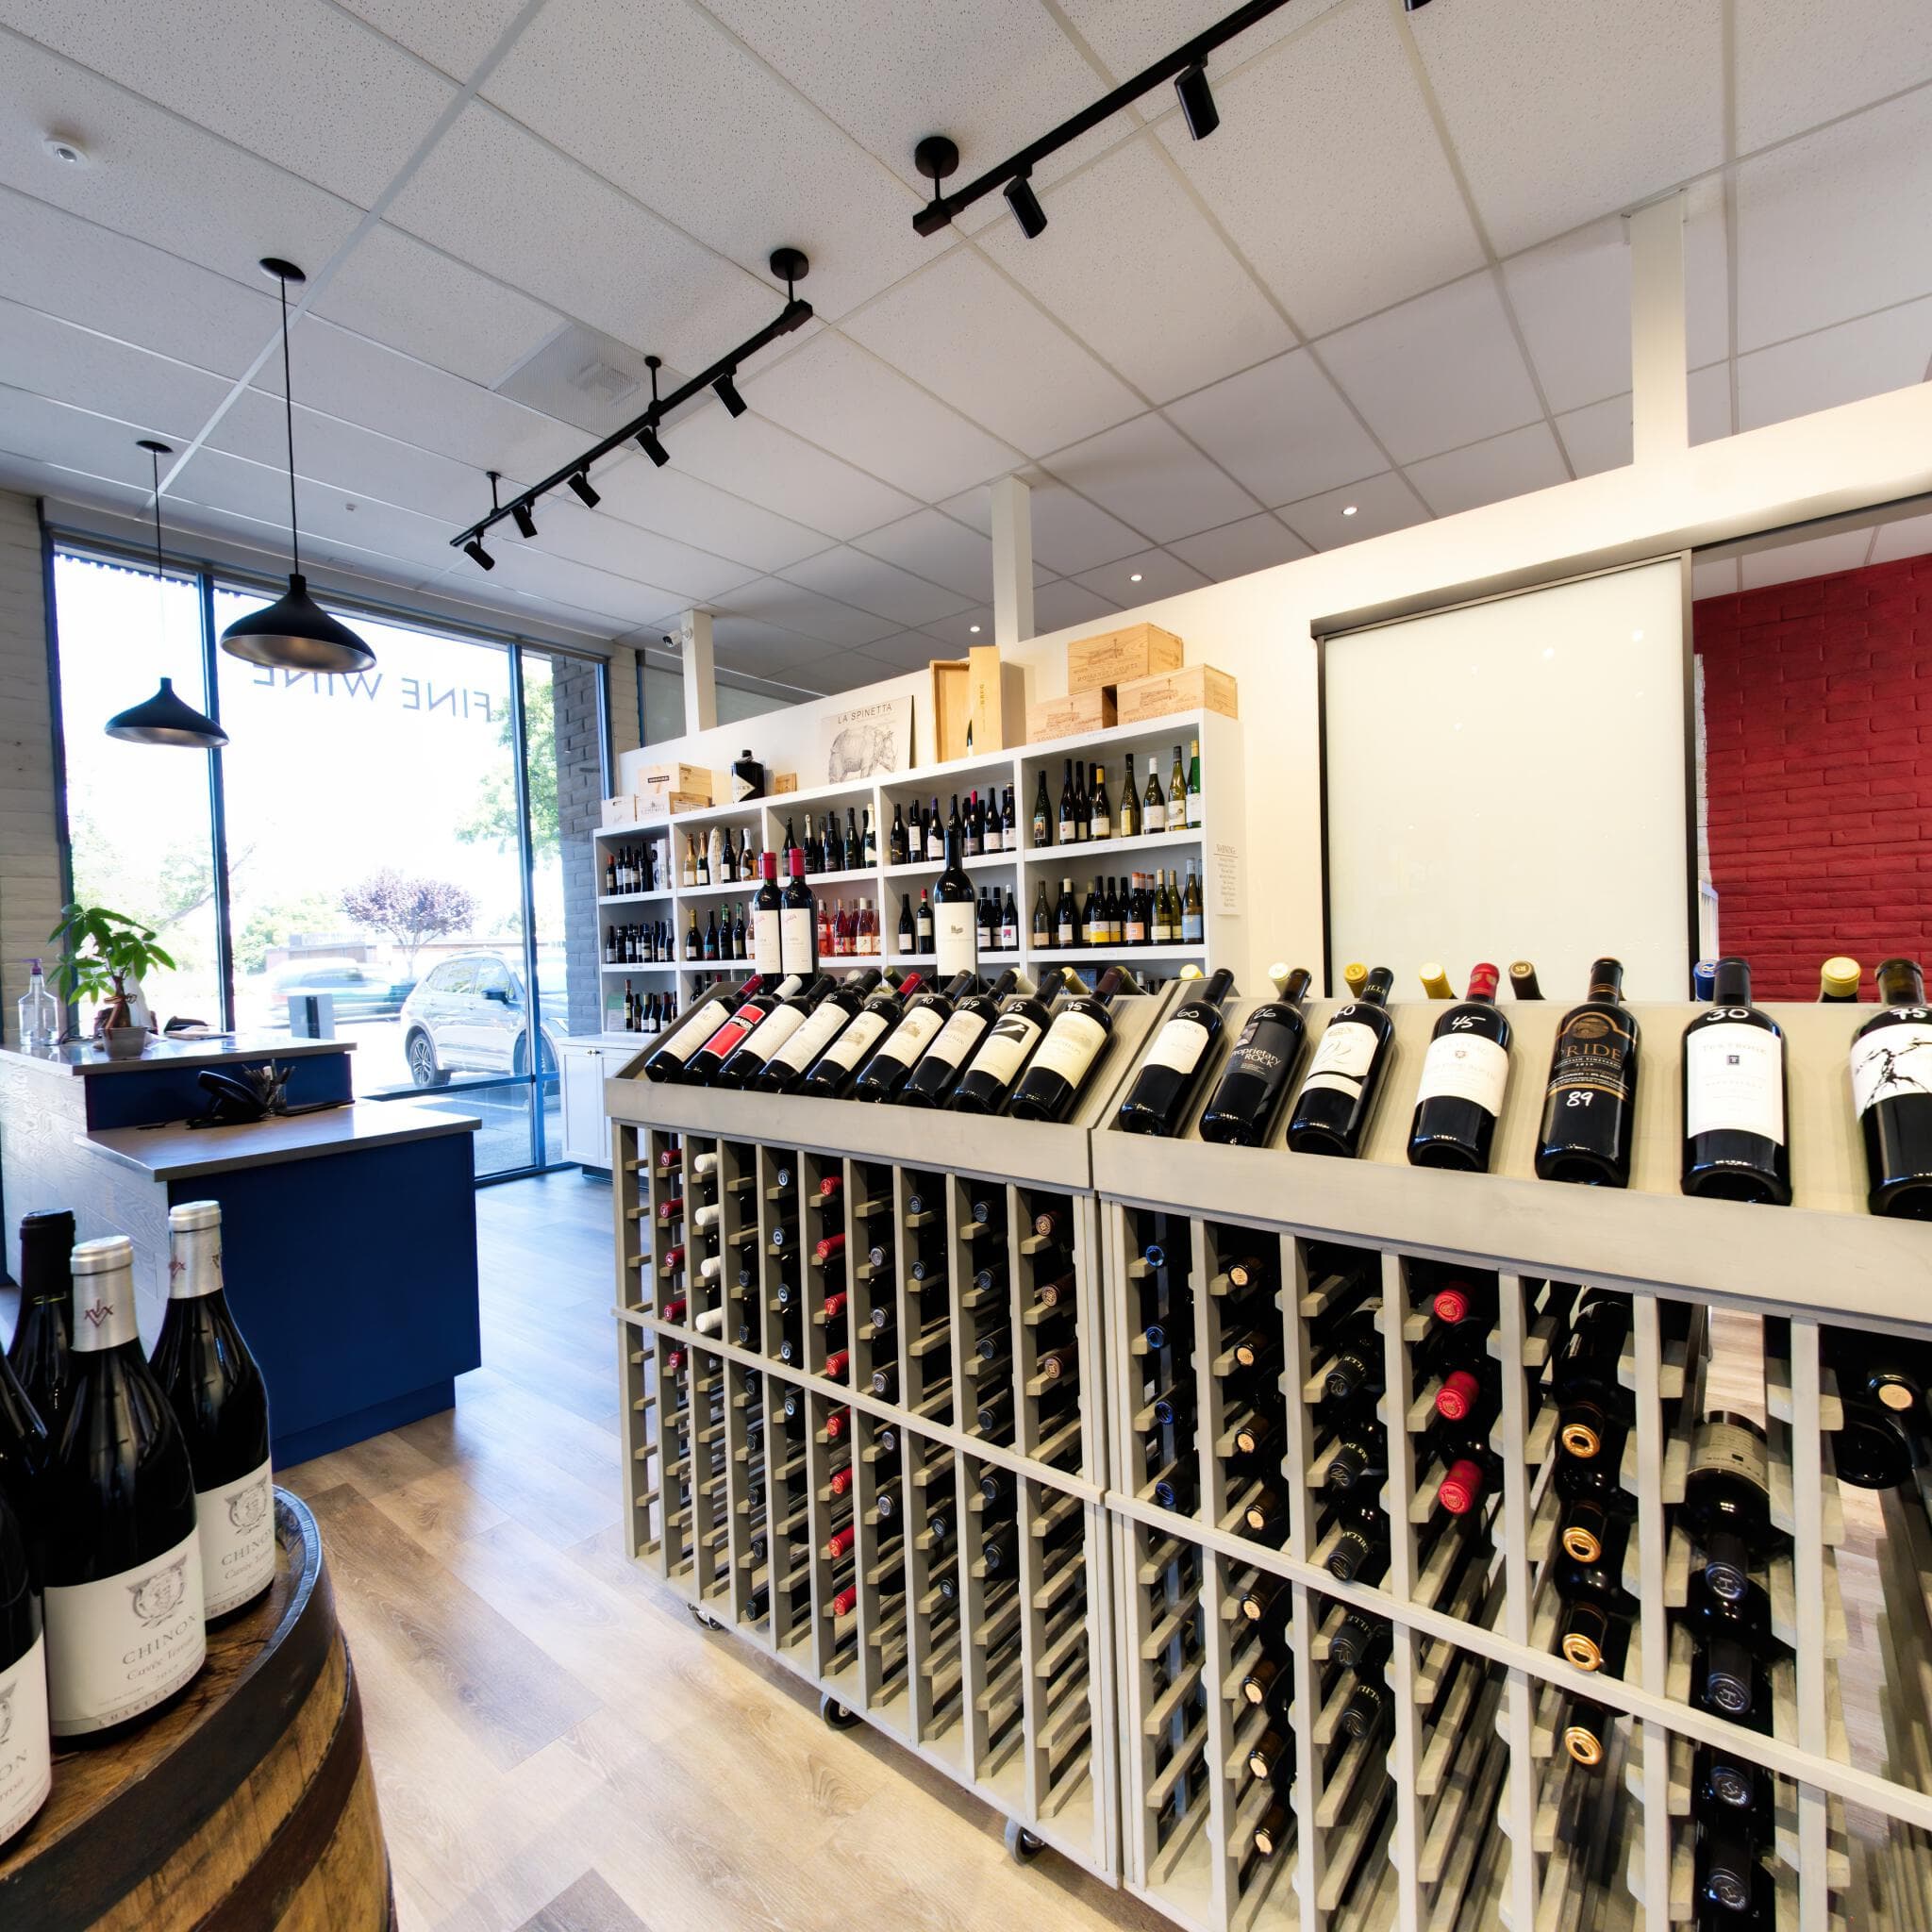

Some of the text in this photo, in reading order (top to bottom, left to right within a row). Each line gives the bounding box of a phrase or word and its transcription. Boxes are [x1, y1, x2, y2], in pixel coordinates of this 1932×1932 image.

[838, 703, 893, 724] LA SPINETTA
[1177, 1008, 1199, 1019] 60
[1707, 1008, 1749, 1022] 30
[1451, 1016, 1487, 1031] 45
[1244, 1053, 1274, 1068] ROCK
[1566, 1091, 1593, 1108] 89
[123, 1615, 196, 1665] CHINON
